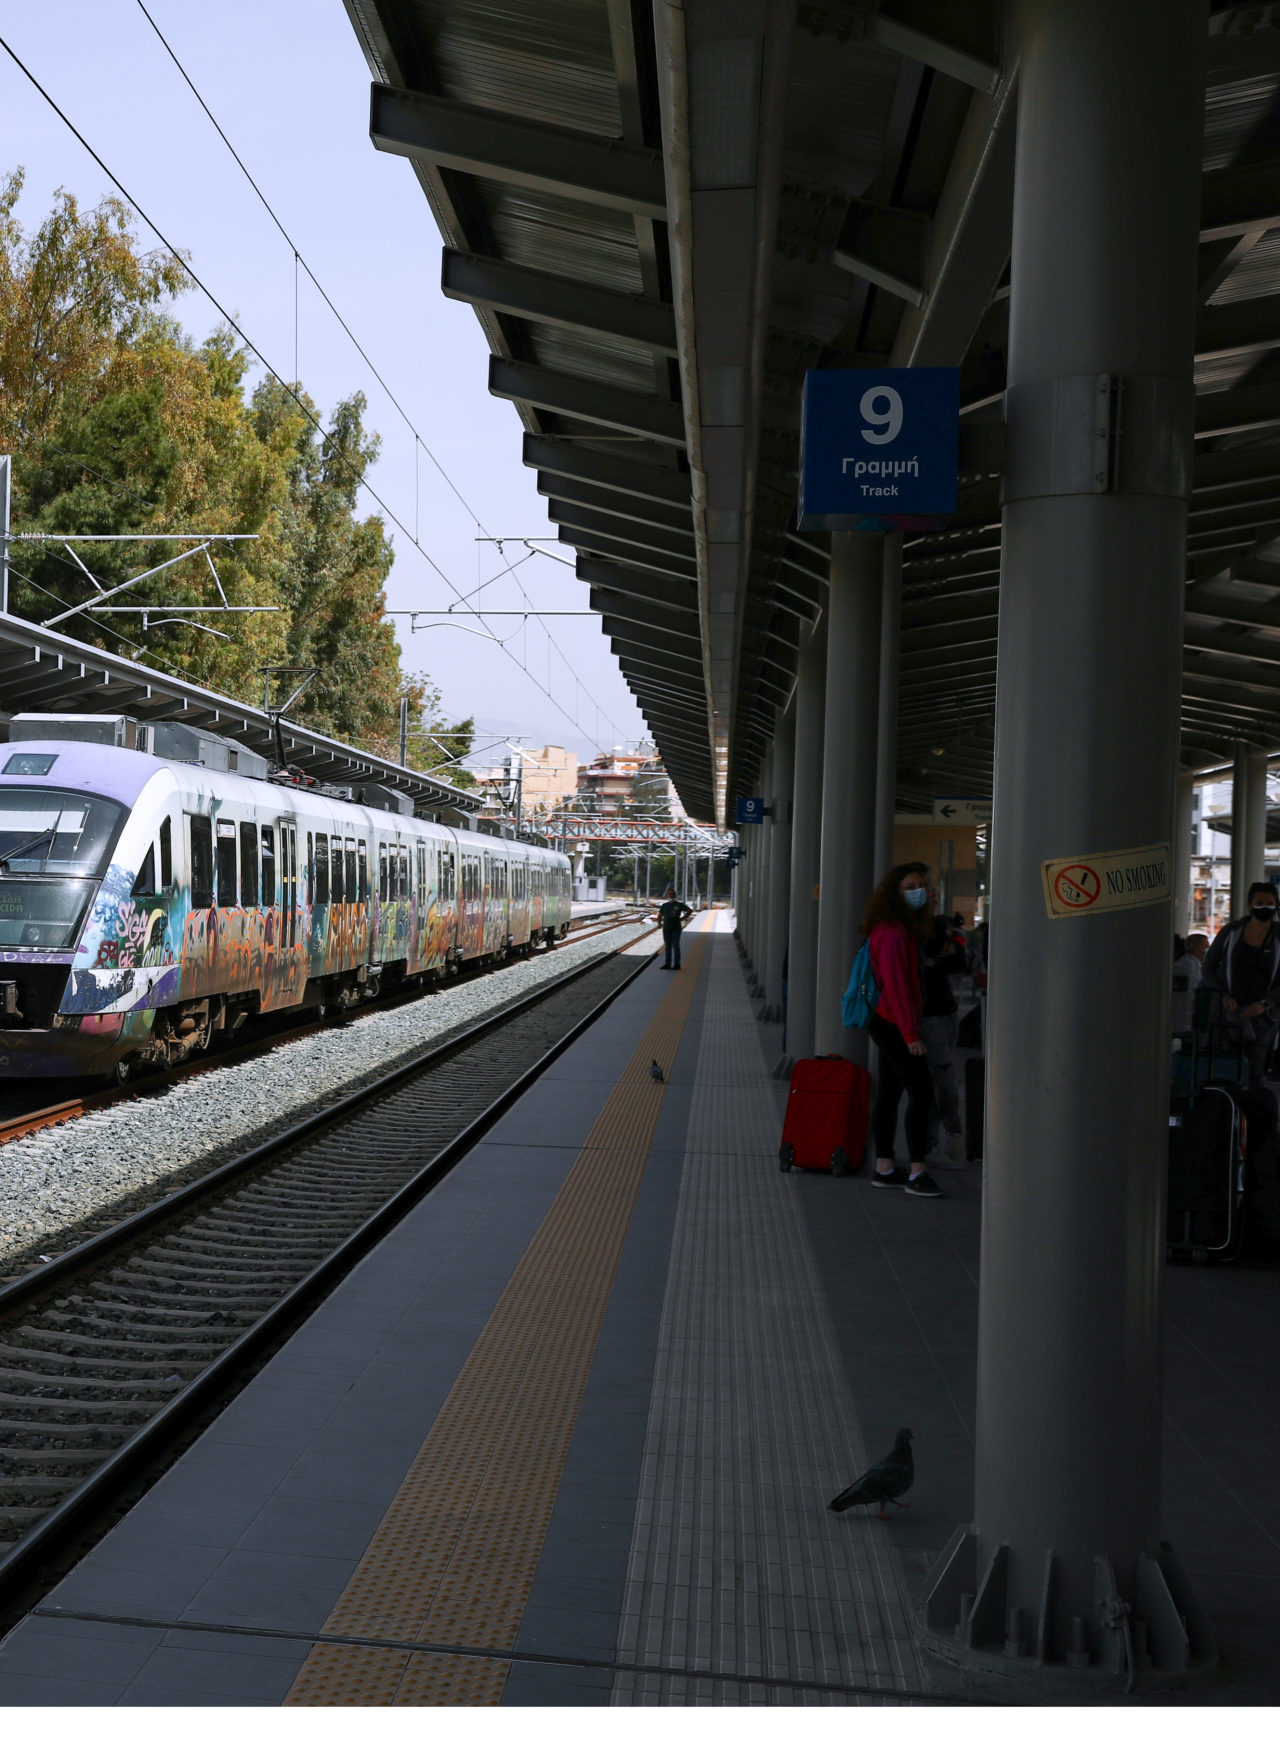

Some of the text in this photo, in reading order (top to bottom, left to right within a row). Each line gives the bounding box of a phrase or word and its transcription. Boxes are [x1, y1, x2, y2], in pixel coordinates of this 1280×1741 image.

[859, 385, 904, 446] 9
[841, 455, 920, 479] Γραμμή
[860, 484, 900, 496] Track
[745, 800, 755, 812] 9
[1106, 862, 1166, 895] NO SMOKING
